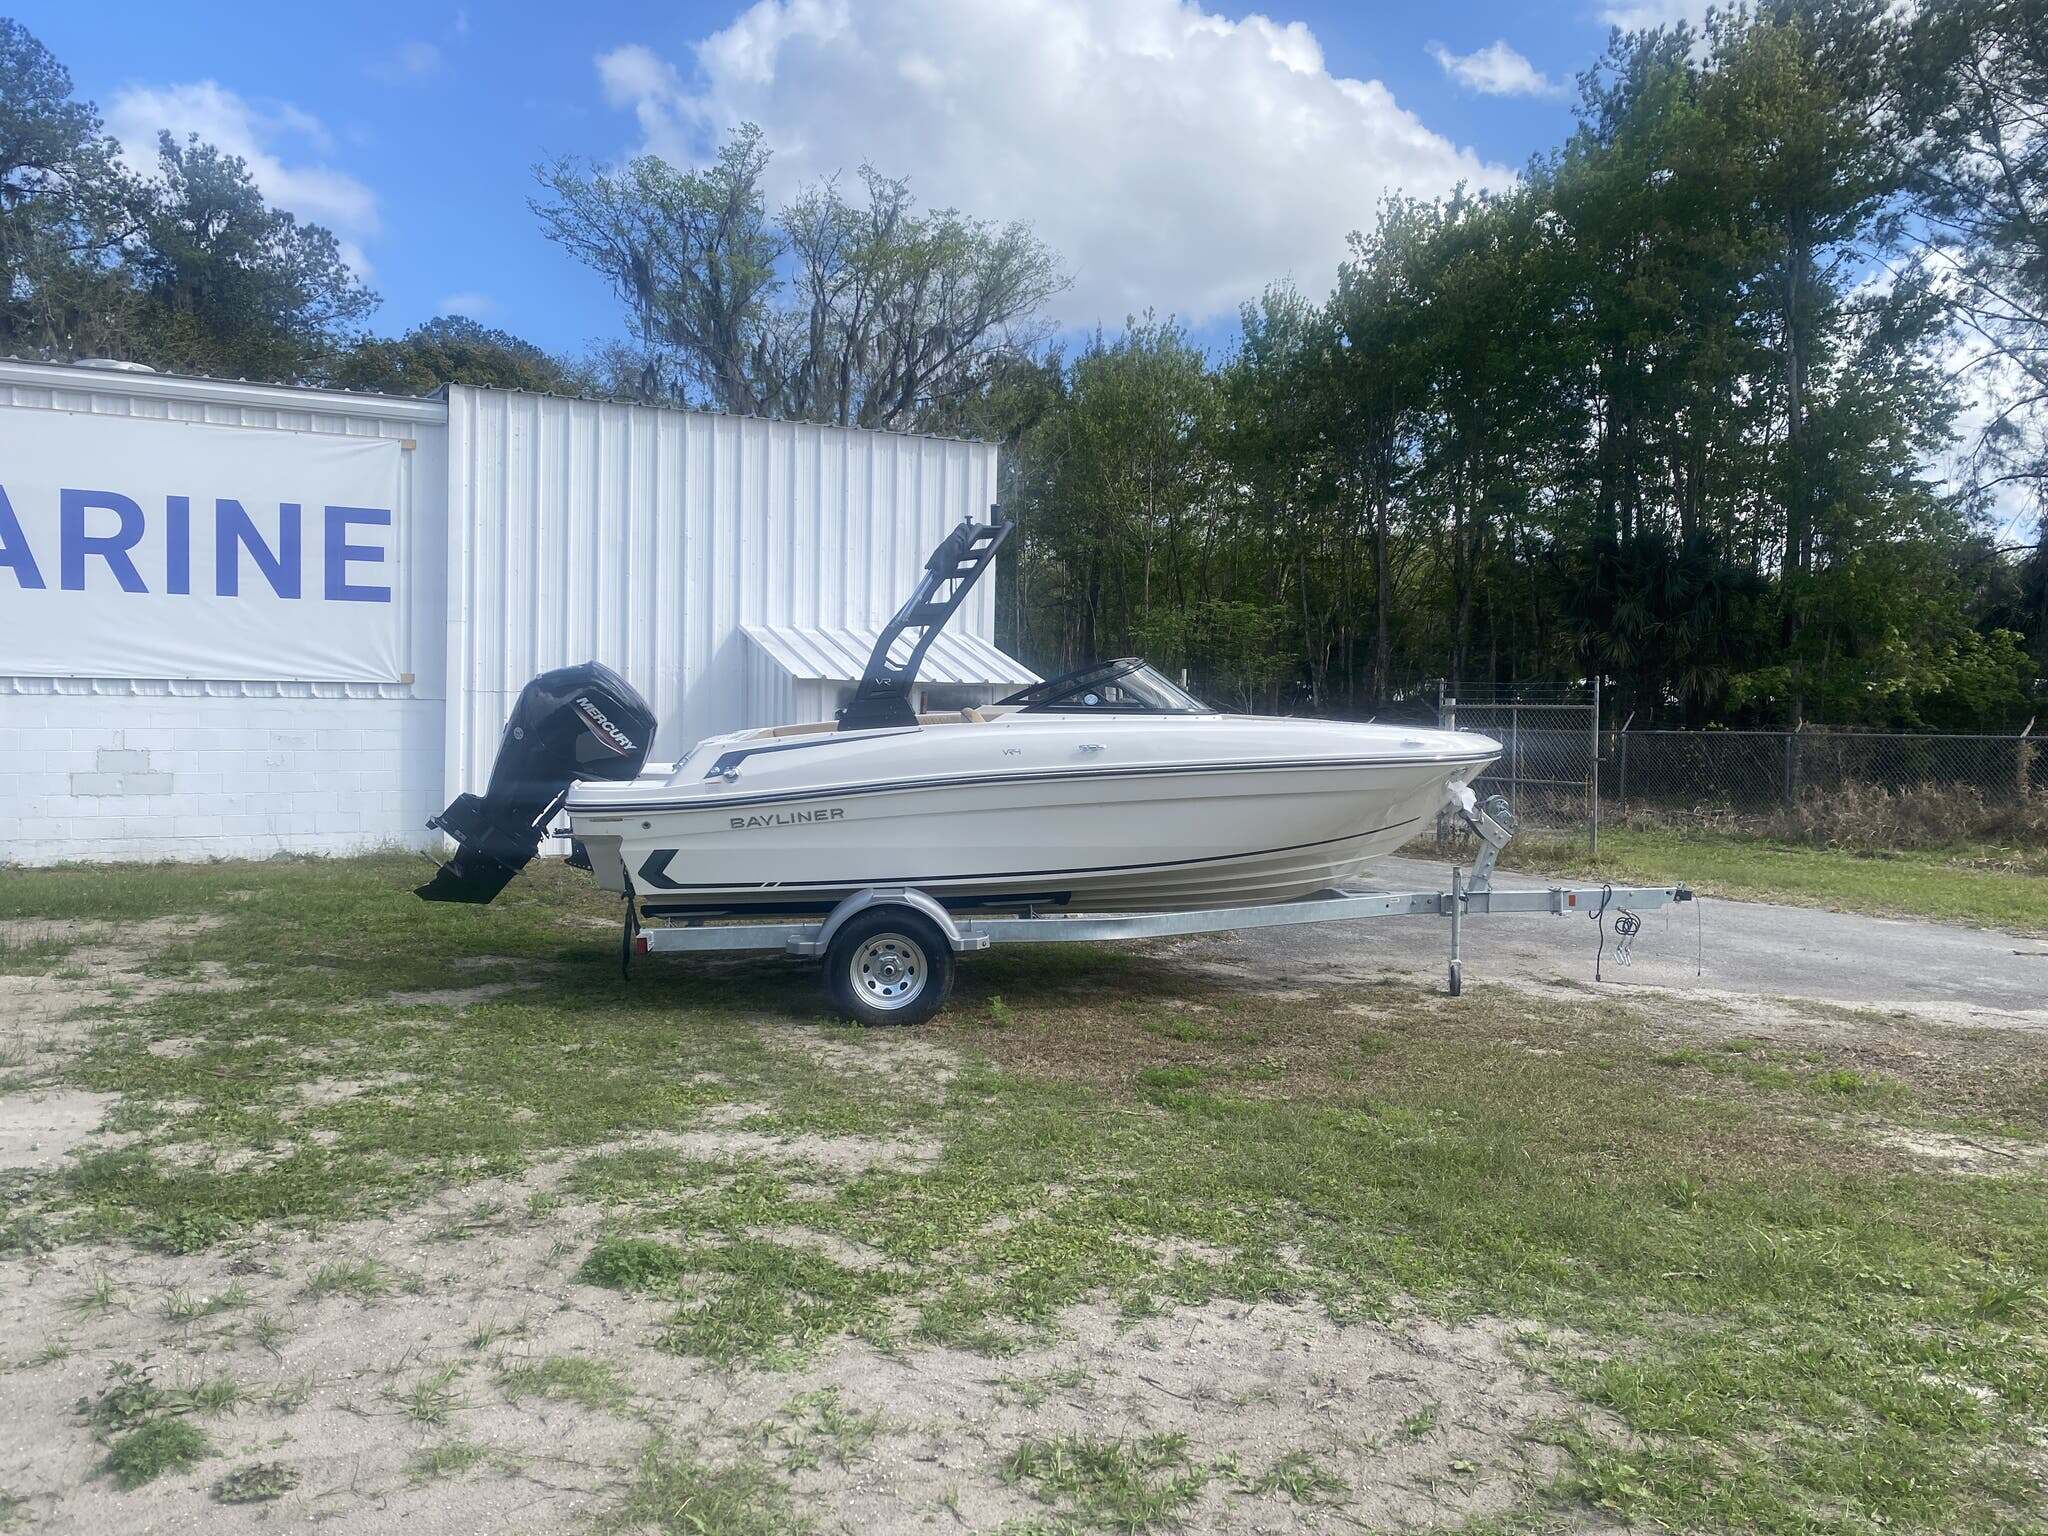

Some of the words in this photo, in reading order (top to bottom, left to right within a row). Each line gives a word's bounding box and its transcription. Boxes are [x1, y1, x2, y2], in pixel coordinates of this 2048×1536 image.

[875, 678, 892, 686] VR
[576, 697, 637, 750] MERCURY
[730, 808, 845, 829] BAYLINER
